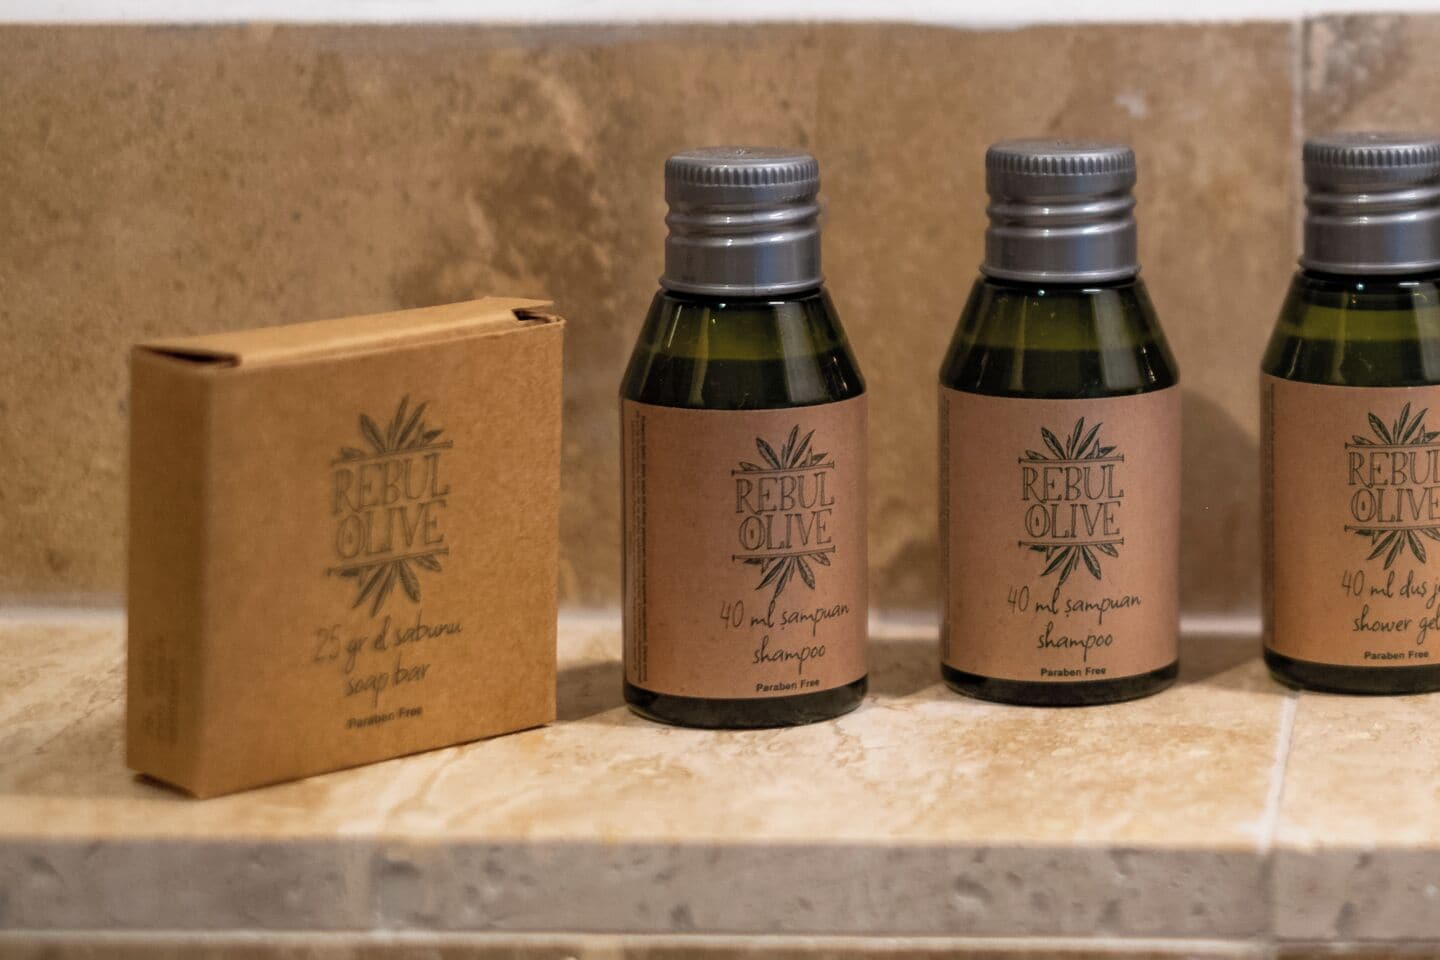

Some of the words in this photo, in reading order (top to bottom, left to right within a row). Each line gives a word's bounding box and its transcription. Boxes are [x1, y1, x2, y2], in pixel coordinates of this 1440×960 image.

[332, 452, 450, 514] REBUL
[735, 471, 835, 515] REBUL
[1022, 463, 1125, 503] REBUL
[335, 499, 447, 559] OLIVE
[738, 509, 832, 551] OLIVE
[1024, 501, 1121, 539] OLIVE
[1341, 569, 1365, 597] 40
[1370, 570, 1395, 598] ml
[719, 599, 745, 629] 40
[750, 599, 775, 628] ml
[780, 604, 849, 637] şampuan
[1007, 585, 1030, 614] 40
[1035, 586, 1060, 615] ml
[1065, 594, 1143, 625] şampuan
[1352, 604, 1413, 632] shower
[752, 634, 826, 675] shampoo
[1036, 620, 1113, 662] shampoo
[1364, 650, 1405, 660] Paraben
[1408, 650, 1430, 659] Free
[344, 671, 390, 708] soap
[393, 652, 431, 686] bar
[756, 682, 797, 693] Paraben
[800, 678, 820, 689] Free
[1040, 667, 1082, 678] Paraben
[1085, 666, 1107, 677] Free
[346, 711, 394, 728] Paraben
[395, 706, 423, 721] Free
